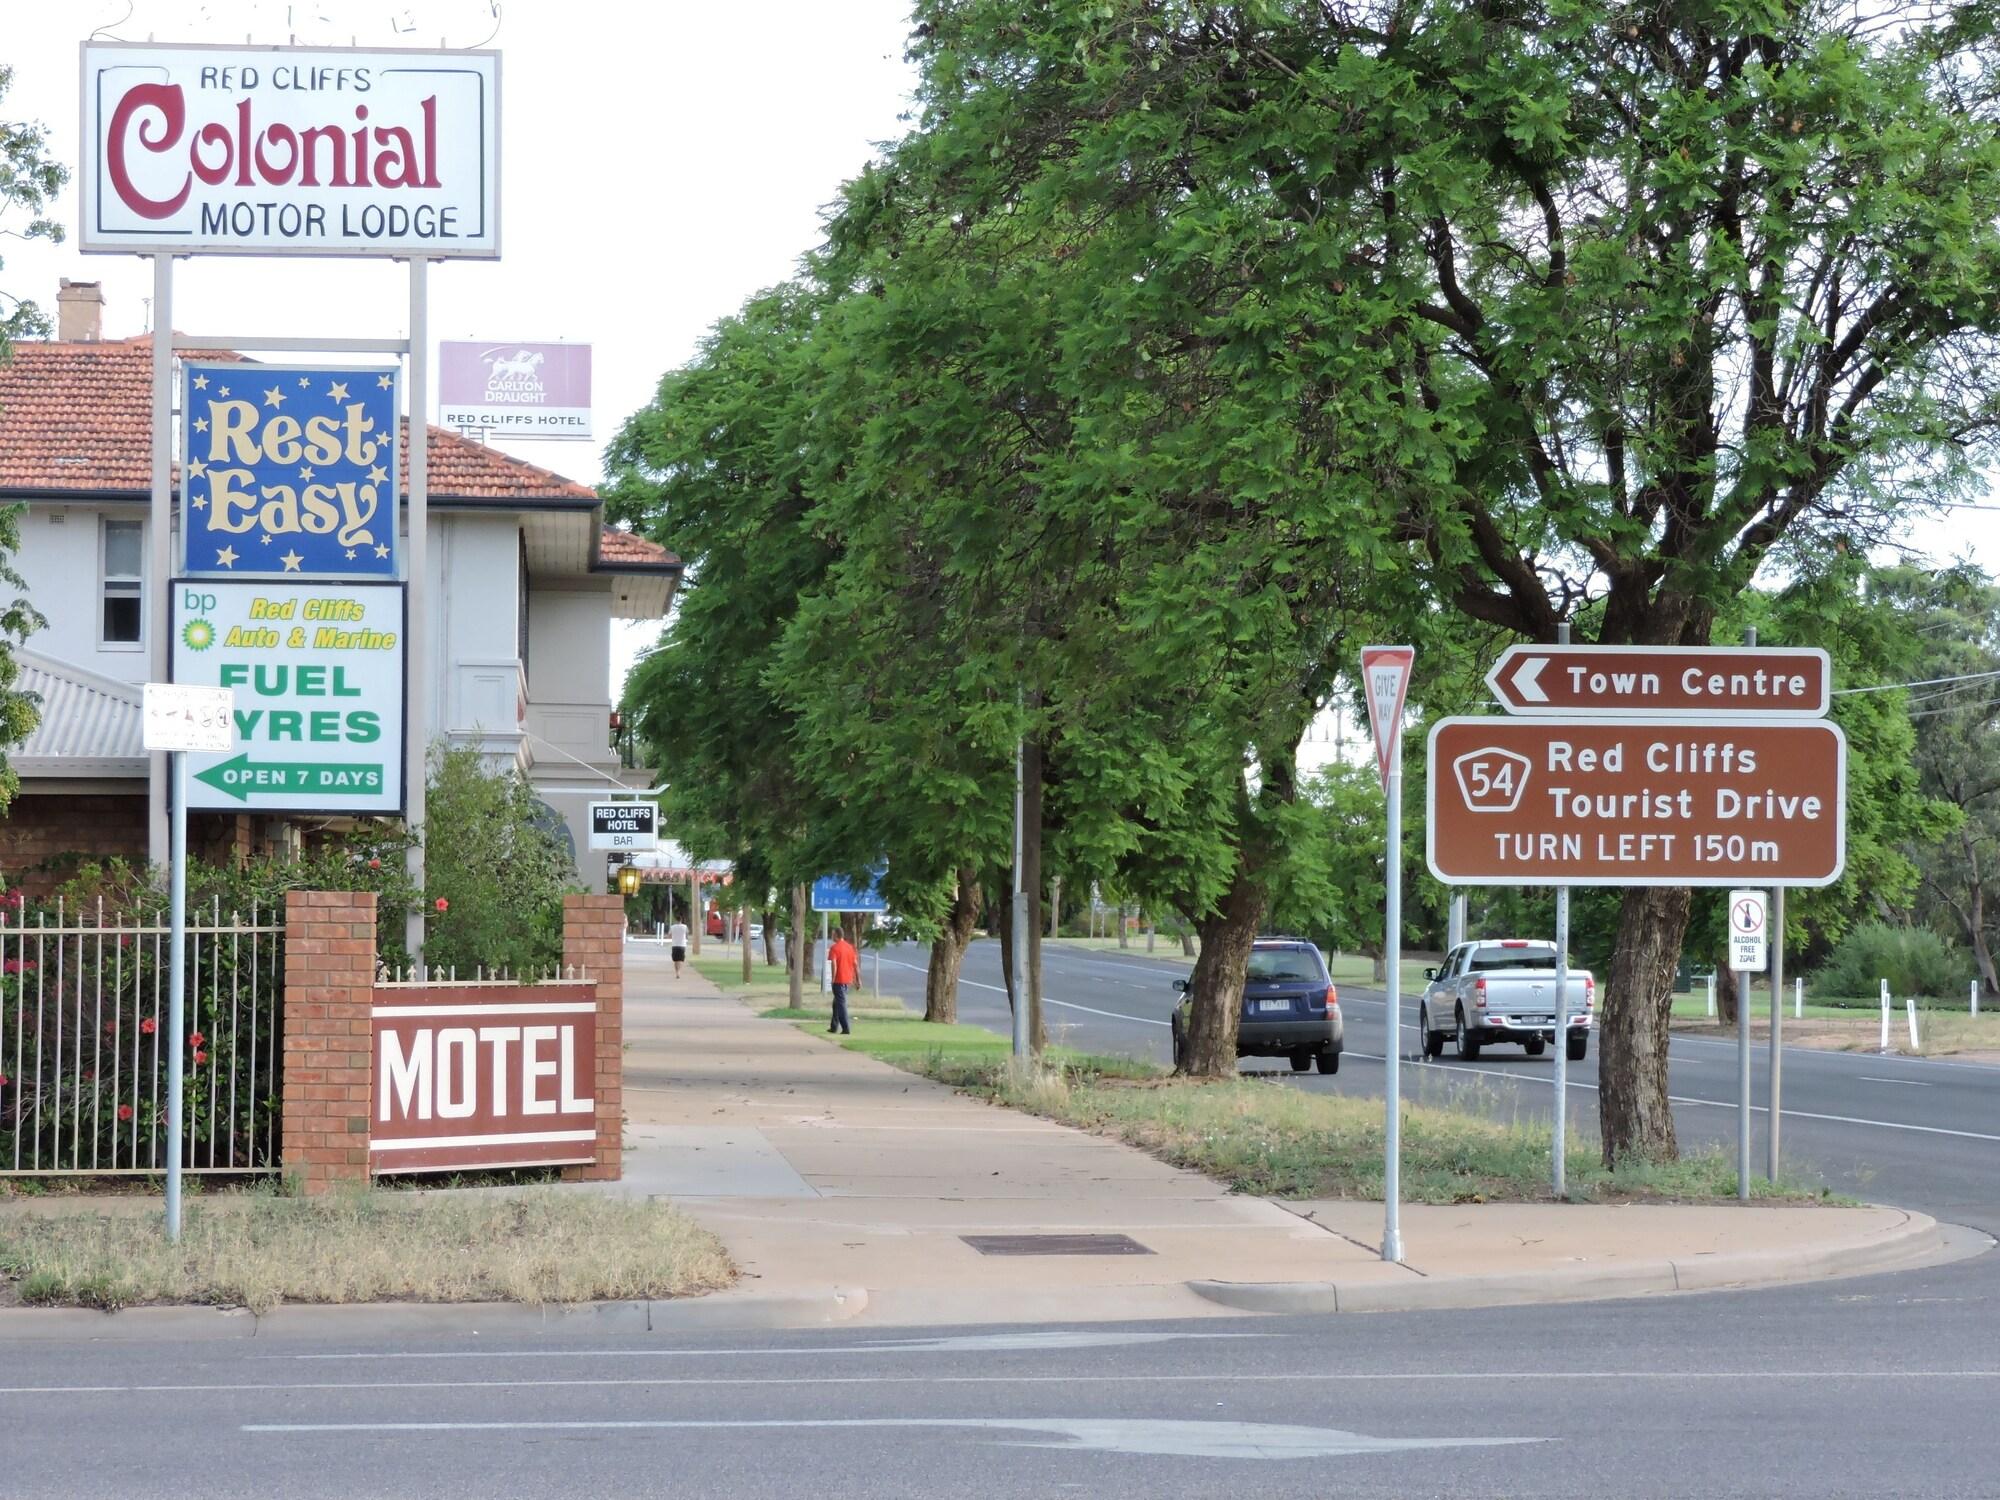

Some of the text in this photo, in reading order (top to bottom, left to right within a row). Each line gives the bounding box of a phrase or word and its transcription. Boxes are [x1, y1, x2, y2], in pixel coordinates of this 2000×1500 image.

[201, 66, 372, 93] RED CLIFFS
[107, 83, 442, 220] Colonial
[202, 201, 459, 238] MOTOR LODGE
[485, 390, 547, 403] DRAUGHT
[487, 380, 544, 391] CARLTON
[207, 399, 378, 466] Rest
[447, 414, 586, 425] RED CLIFFS HOTEL
[206, 468, 378, 547] Easy
[184, 588, 217, 616] bp
[249, 597, 365, 622] Red Cliffs
[223, 626, 397, 650] Auto & Marine
[220, 663, 362, 697] FUEL
[1374, 675, 1397, 697] GIVE
[1566, 666, 1807, 696] Town Centre
[1378, 704, 1391, 721] WAY
[233, 709, 382, 743] YRES
[1547, 741, 1757, 774] Red Cliffs
[222, 769, 379, 786] OPEN 7 DAYS
[1470, 762, 1514, 797] 54
[596, 808, 651, 819] RED CLIFFS
[1548, 787, 1822, 820] Tourist Drive
[607, 820, 640, 830] HOTEL
[613, 836, 633, 845] BAR
[1494, 833, 1582, 861] TURN
[1598, 833, 1676, 861] LEFT
[1734, 936, 1762, 944] ALCOHOL
[1740, 945, 1756, 954] FREE
[1739, 955, 1756, 963] ZONE
[379, 1025, 595, 1122] MOTEL
